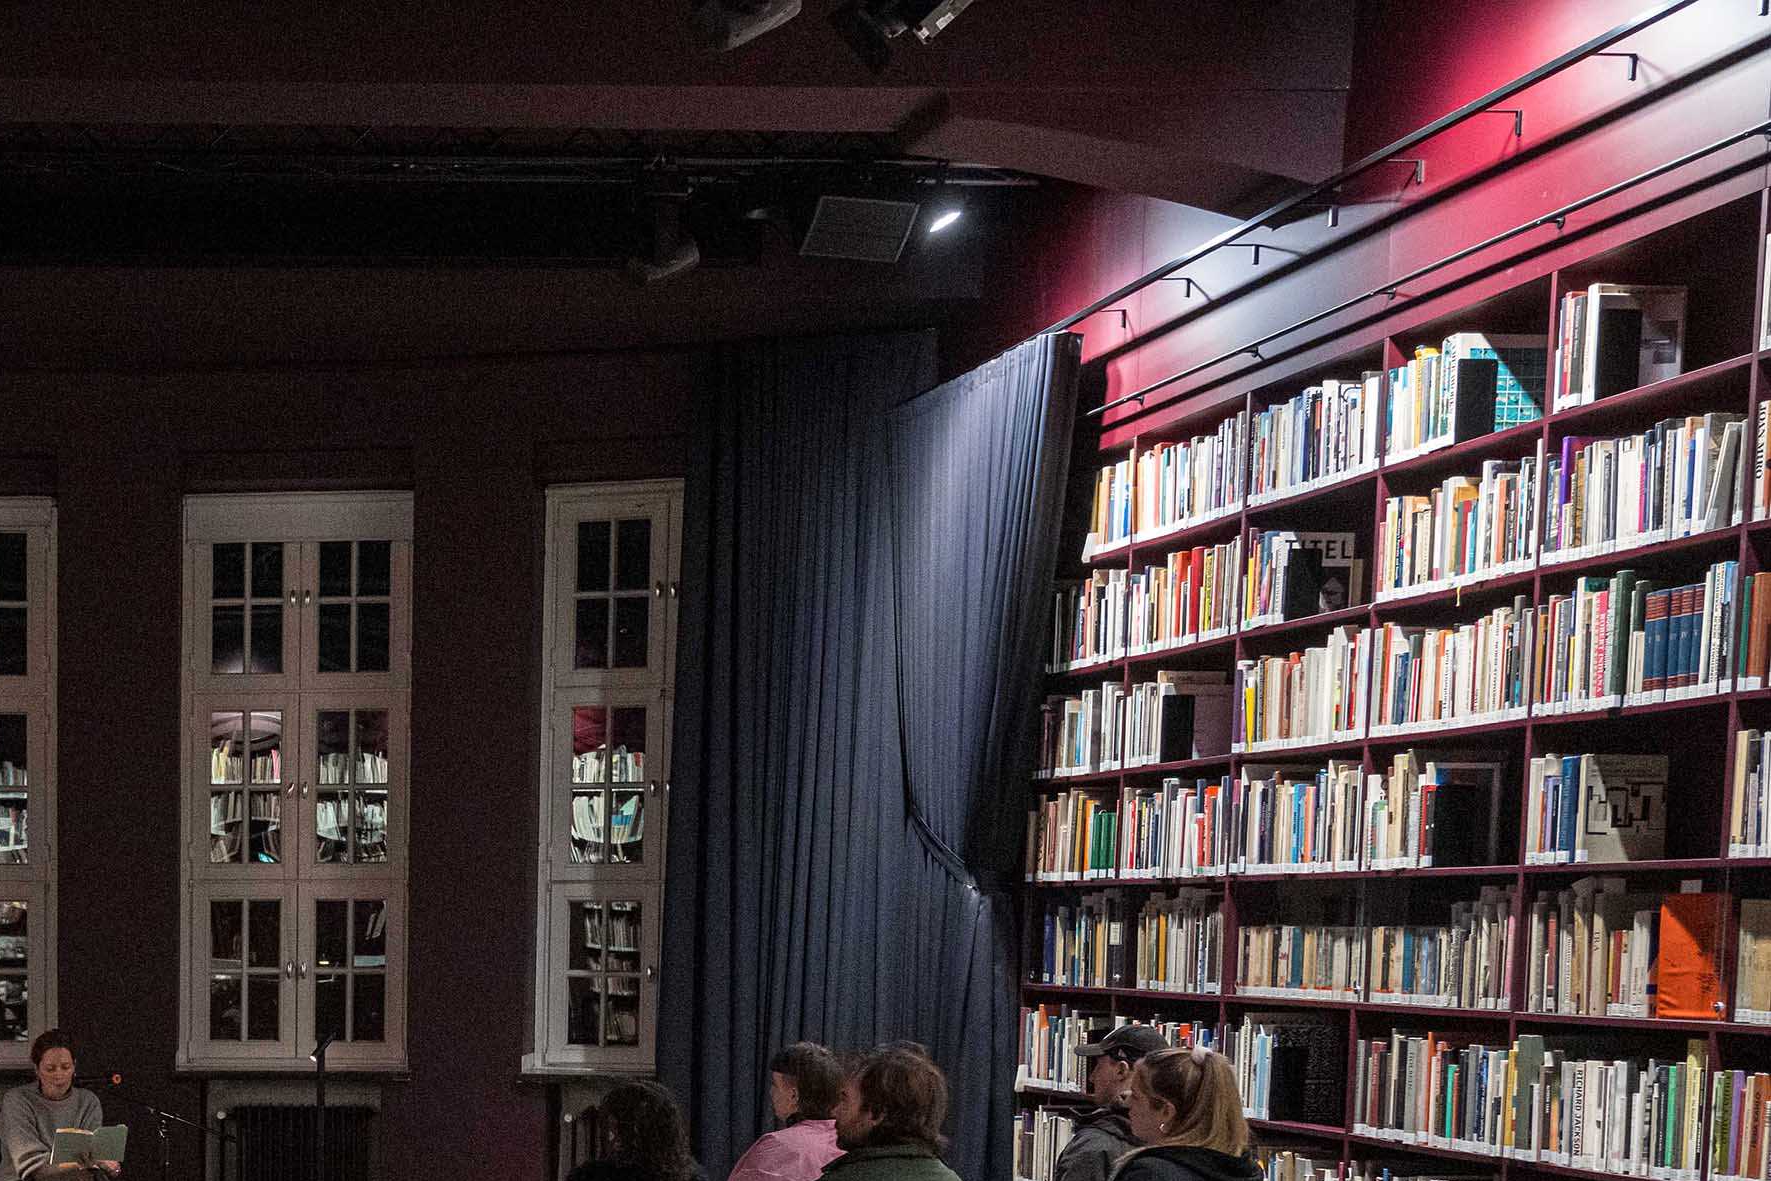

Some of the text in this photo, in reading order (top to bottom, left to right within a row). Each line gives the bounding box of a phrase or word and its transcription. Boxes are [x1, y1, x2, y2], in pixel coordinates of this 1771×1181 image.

[1757, 402, 1766, 438] JOAN
[1595, 613, 1606, 692] ROBERT INDIANA
[1573, 1069, 1583, 1156] RICHARD JACKSON
